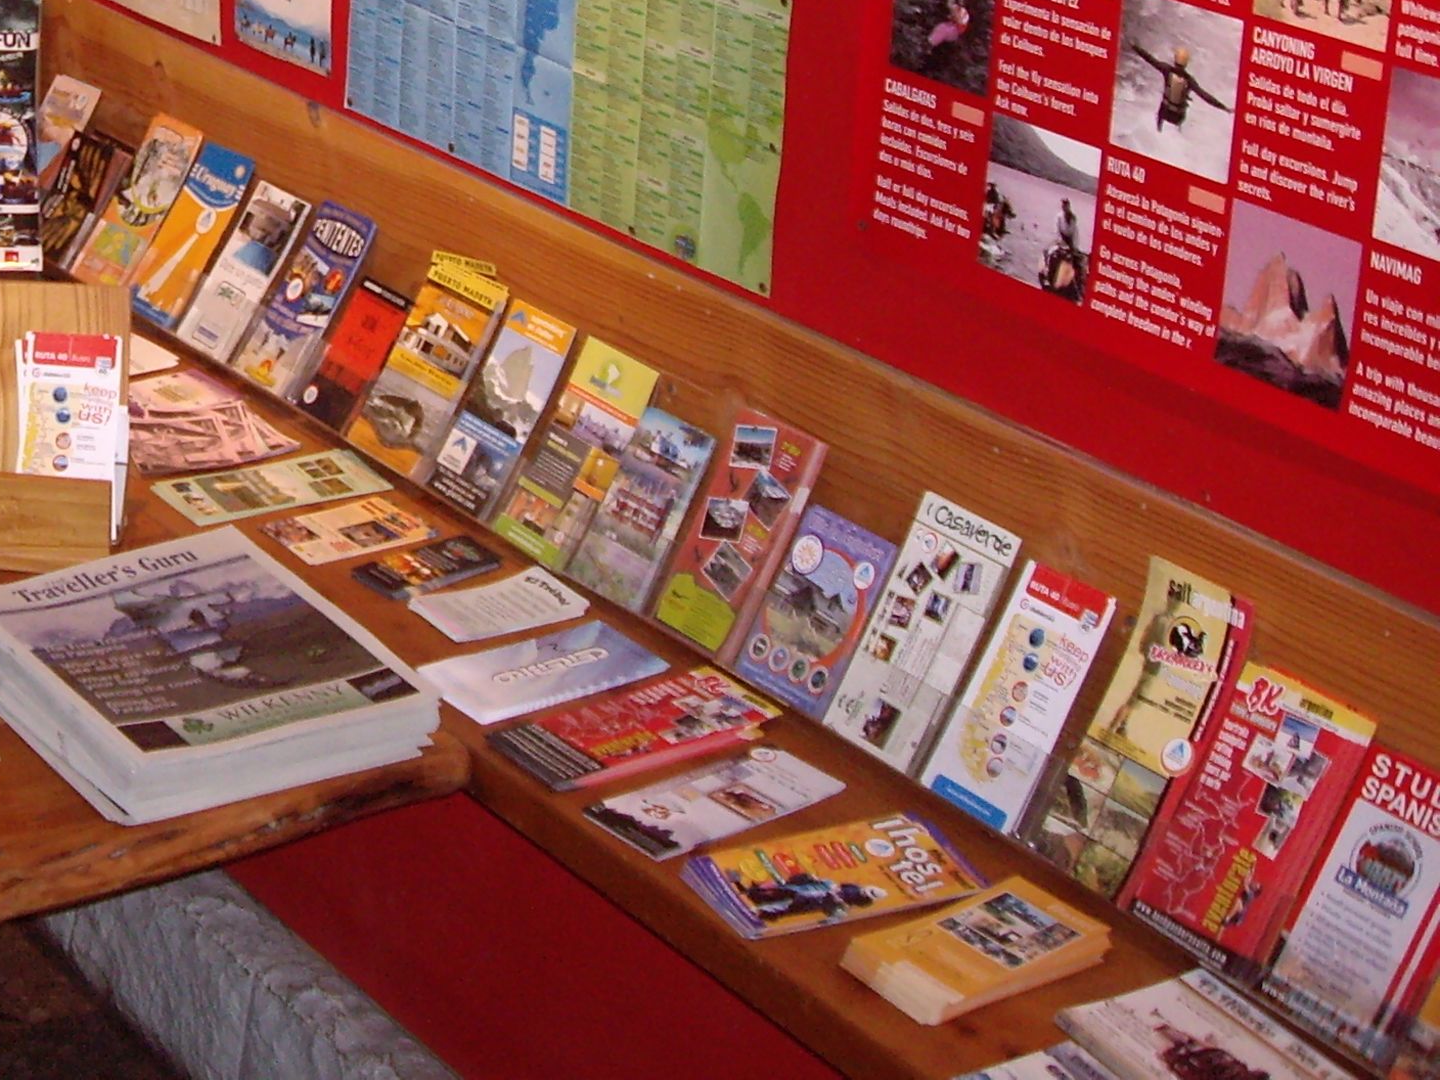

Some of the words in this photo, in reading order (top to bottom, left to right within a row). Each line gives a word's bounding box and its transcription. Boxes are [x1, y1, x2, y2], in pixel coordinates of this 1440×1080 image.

[1252, 25, 1315, 60] CANYONING
[1251, 46, 1294, 75] ARROYO
[1295, 61, 1311, 80] LA
[1312, 64, 1354, 93] VIRGEN
[1107, 155, 1131, 180] RUTA
[1132, 166, 1146, 184] 40
[312, 218, 365, 258] PENITENTES
[1370, 250, 1422, 285] NAVIMAG
[83, 382, 117, 400] keep
[935, 505, 1012, 556] Casaverde
[12, 565, 138, 603] Traveller's
[138, 550, 199, 572] Guru
[1060, 632, 1089, 661] keep
[1372, 753, 1440, 807] STUD
[1362, 776, 1440, 838] SPANIS
